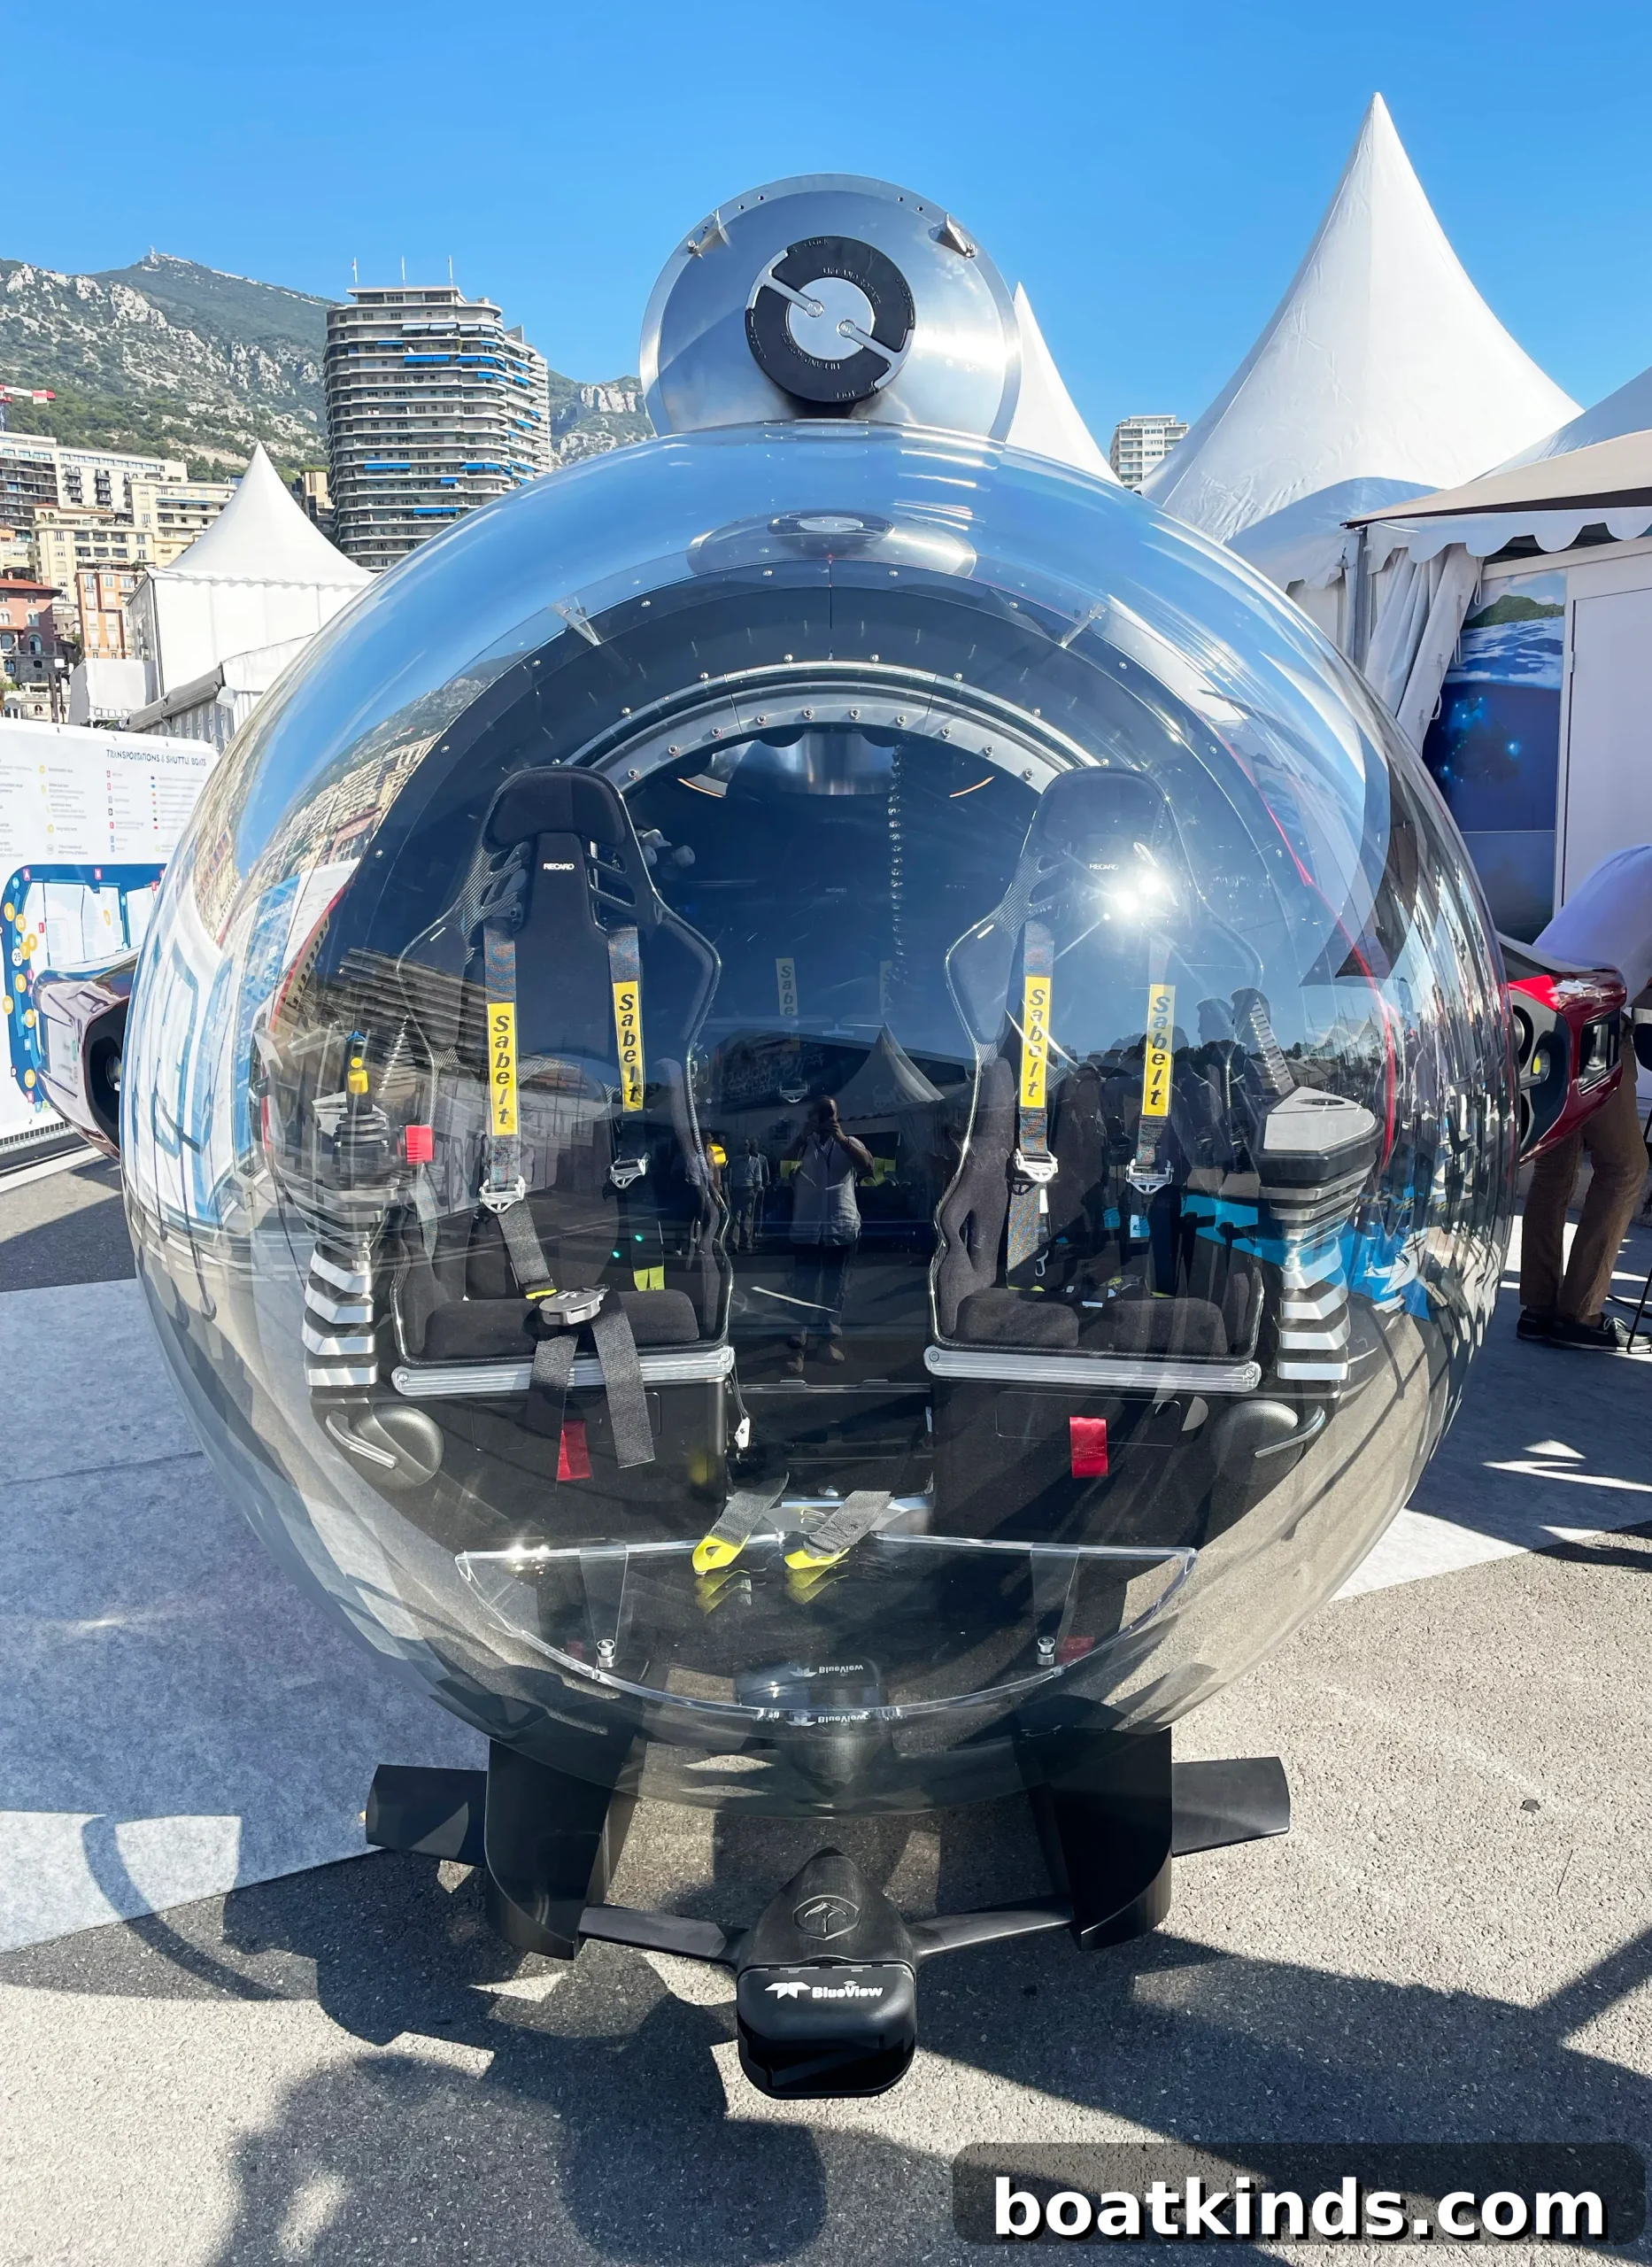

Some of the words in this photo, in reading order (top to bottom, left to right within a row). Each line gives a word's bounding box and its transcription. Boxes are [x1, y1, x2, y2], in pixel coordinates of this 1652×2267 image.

[106, 749, 160, 762] TRANSPORTATIONS
[166, 755, 189, 765] SHUTTLE
[191, 757, 206, 766] BOATS
[13, 952, 21, 962] 25
[780, 965, 795, 1016] Sabe
[492, 1014, 512, 1126] Sabelt
[618, 993, 638, 1103] Sabelt
[1026, 987, 1046, 1098] Sabelt
[1149, 995, 1170, 1107] Sabelt
[812, 1985, 884, 1999] BlueView
